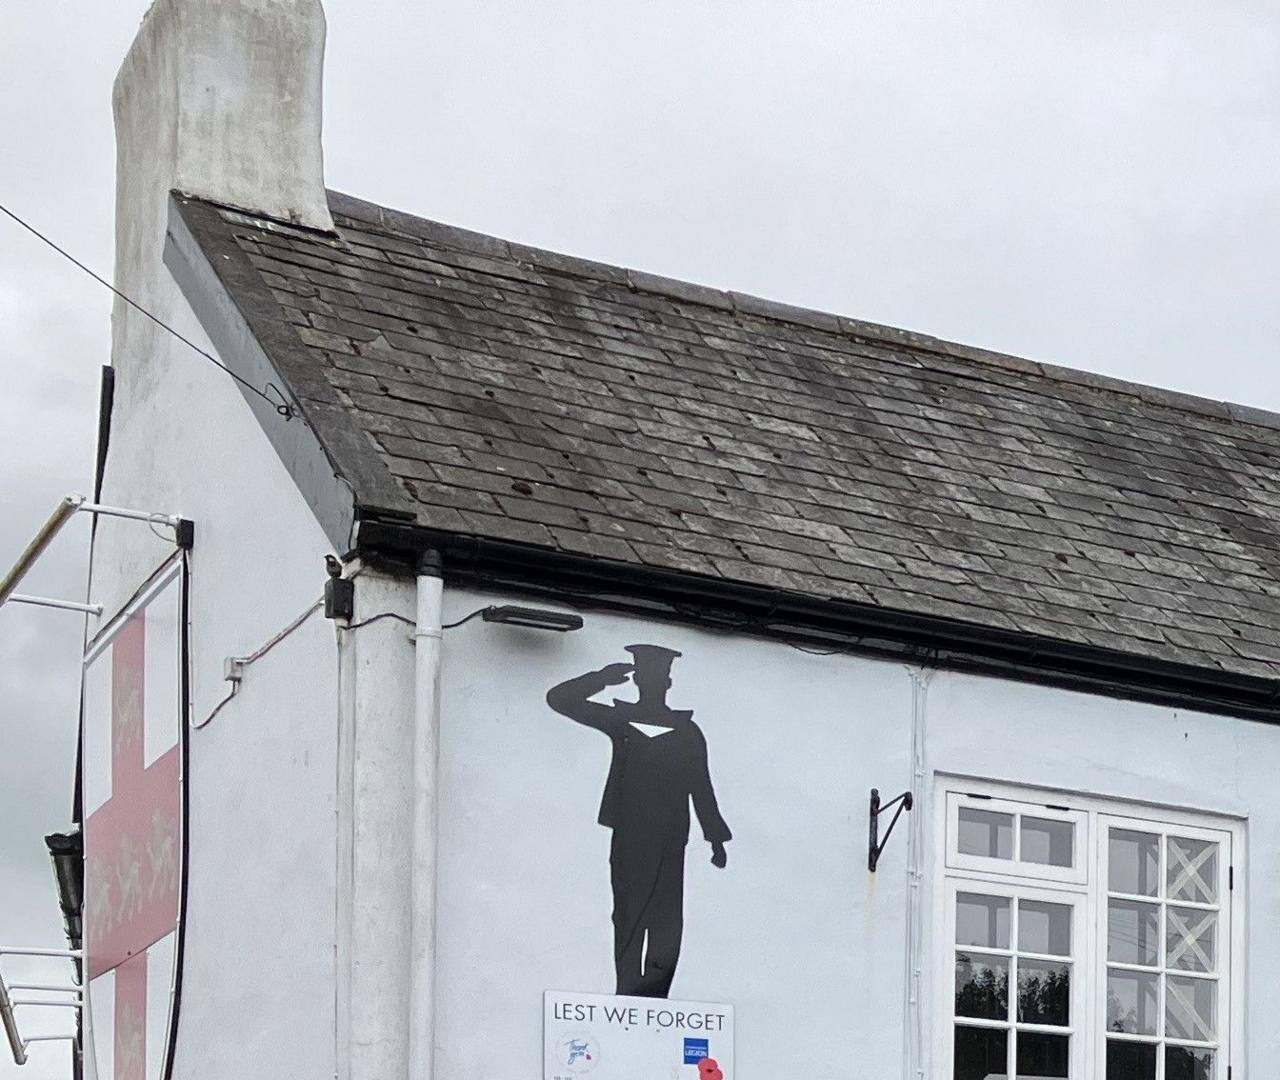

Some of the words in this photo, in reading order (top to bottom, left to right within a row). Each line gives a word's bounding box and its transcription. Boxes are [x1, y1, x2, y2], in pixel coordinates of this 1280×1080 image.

[554, 1002, 596, 1021] LEST
[604, 1006, 638, 1025] WE
[646, 1009, 725, 1031] FORGET
